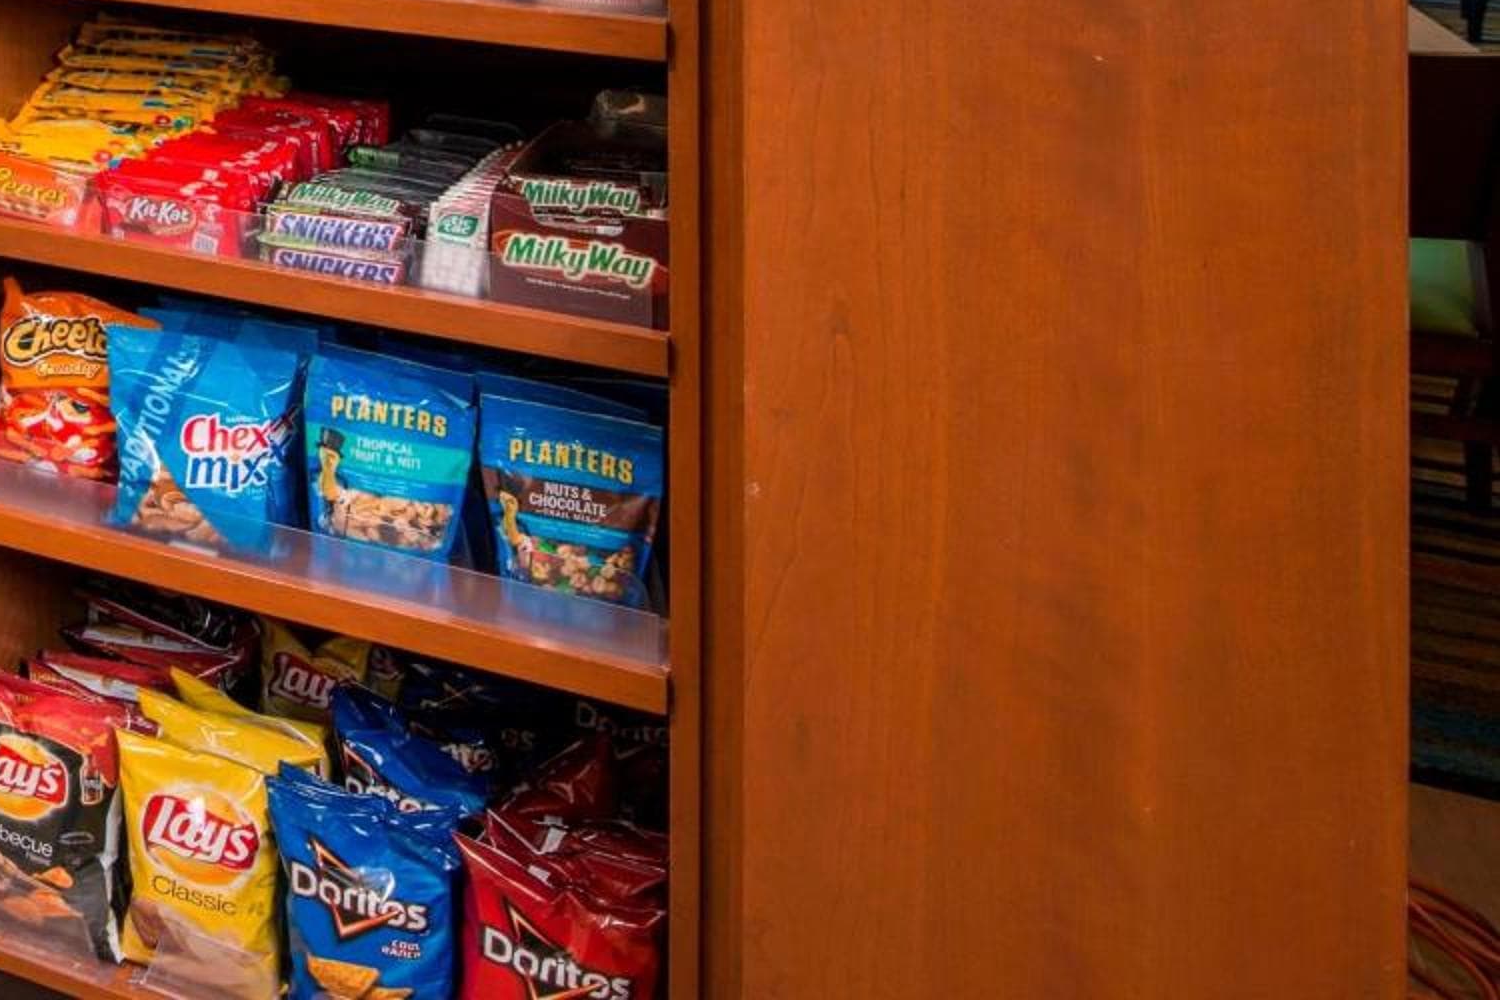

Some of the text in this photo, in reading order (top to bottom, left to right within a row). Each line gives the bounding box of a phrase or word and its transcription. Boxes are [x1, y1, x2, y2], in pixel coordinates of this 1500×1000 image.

[277, 212, 398, 251] SNICKERS
[181, 415, 270, 454] Chex
[330, 395, 448, 438] PLANTERS
[356, 436, 414, 456] TROPICAL
[509, 439, 634, 484] PLANTERS
[187, 454, 268, 491] mix
[544, 481, 592, 502] NUTS &
[528, 492, 608, 518] CHOCOLATE
[146, 797, 260, 867] Lay's
[151, 874, 238, 917] Classic
[290, 863, 428, 933] Doritos
[482, 927, 631, 1000] Doritos
